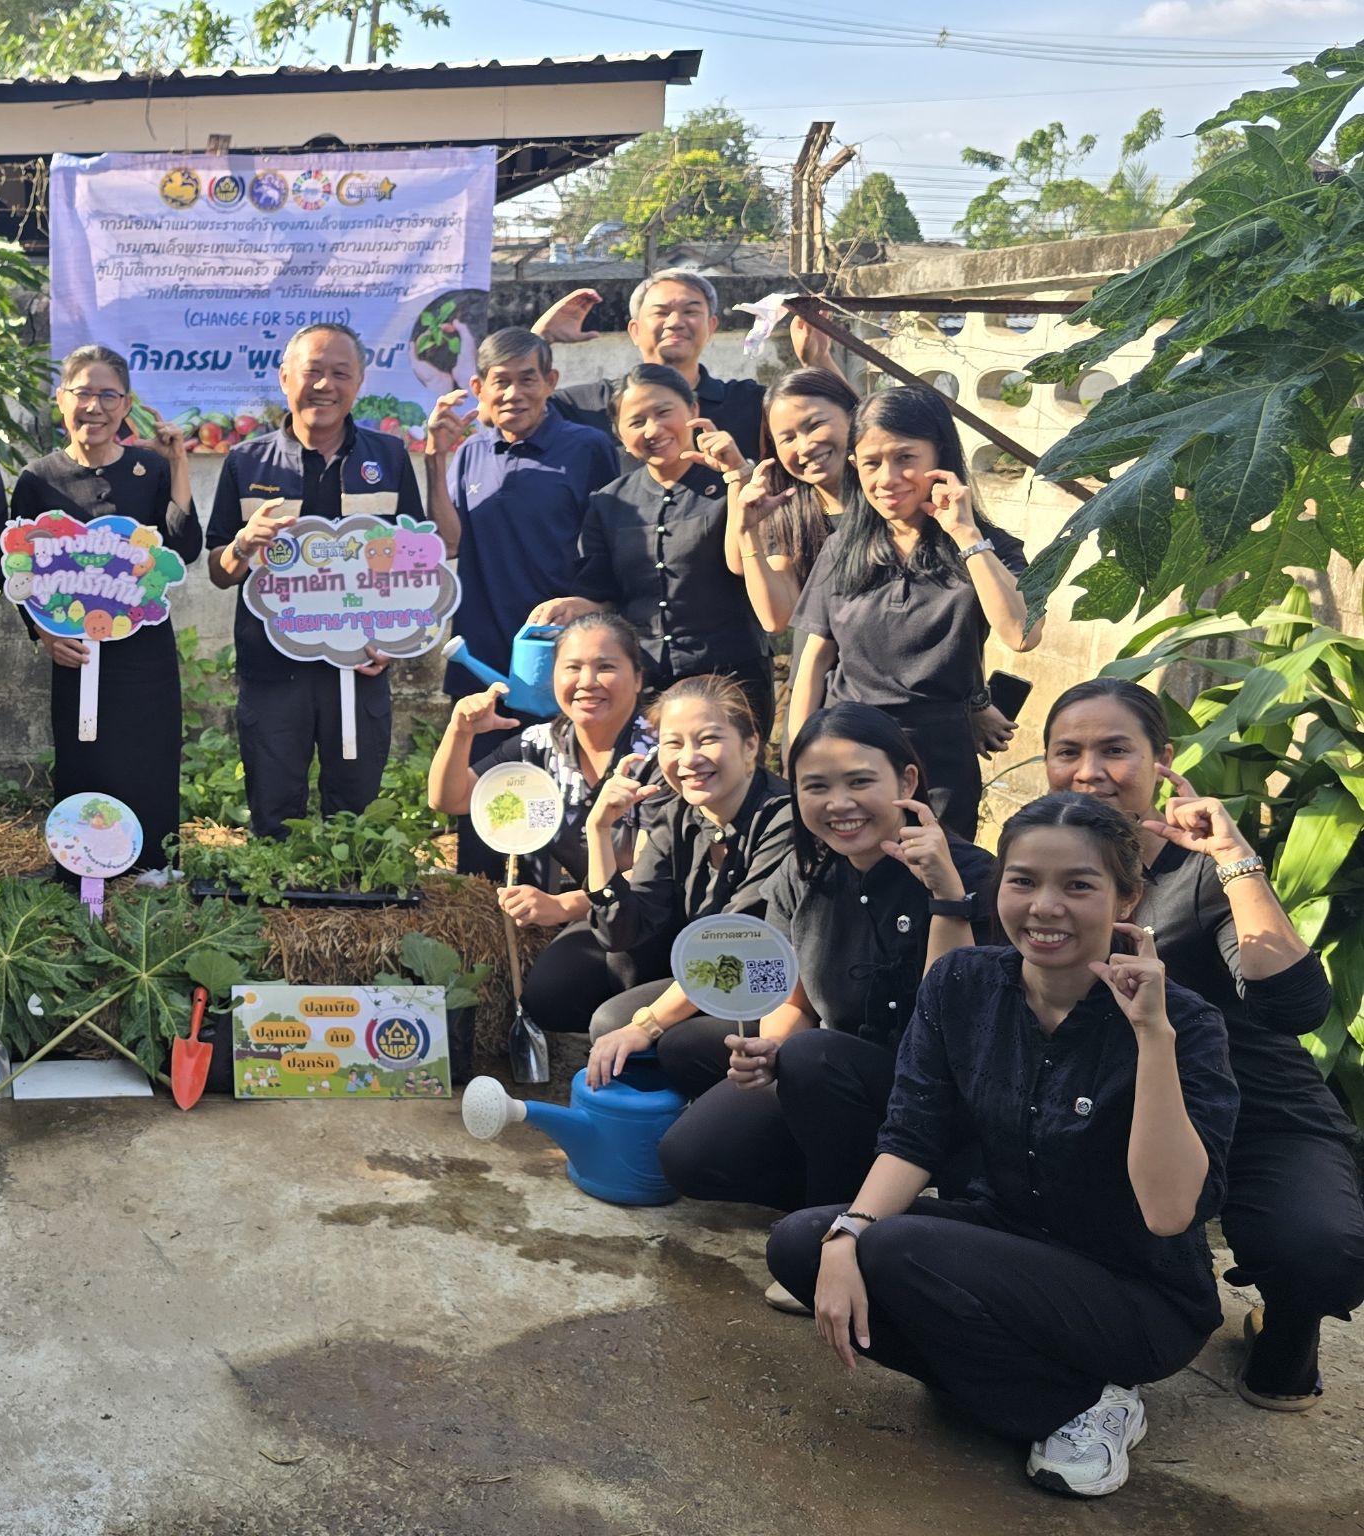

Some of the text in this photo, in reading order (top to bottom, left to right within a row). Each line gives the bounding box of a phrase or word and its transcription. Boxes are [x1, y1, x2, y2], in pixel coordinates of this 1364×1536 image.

[185, 307, 249, 329] (CHANGE
[253, 311, 280, 326] FOR
[128, 343, 231, 371] กิจกรรม
[257, 562, 441, 602] ปลูกผัก ปลูกรัก
[342, 593, 363, 608] กับ
[273, 607, 434, 640] พัฒนาชุมชน
[507, 775, 526, 786] ผักชี
[701, 930, 761, 940] ผักกาดหวาน
[304, 1001, 355, 1016] ปลูกพืช
[287, 1056, 335, 1071] ปลูกรัก
